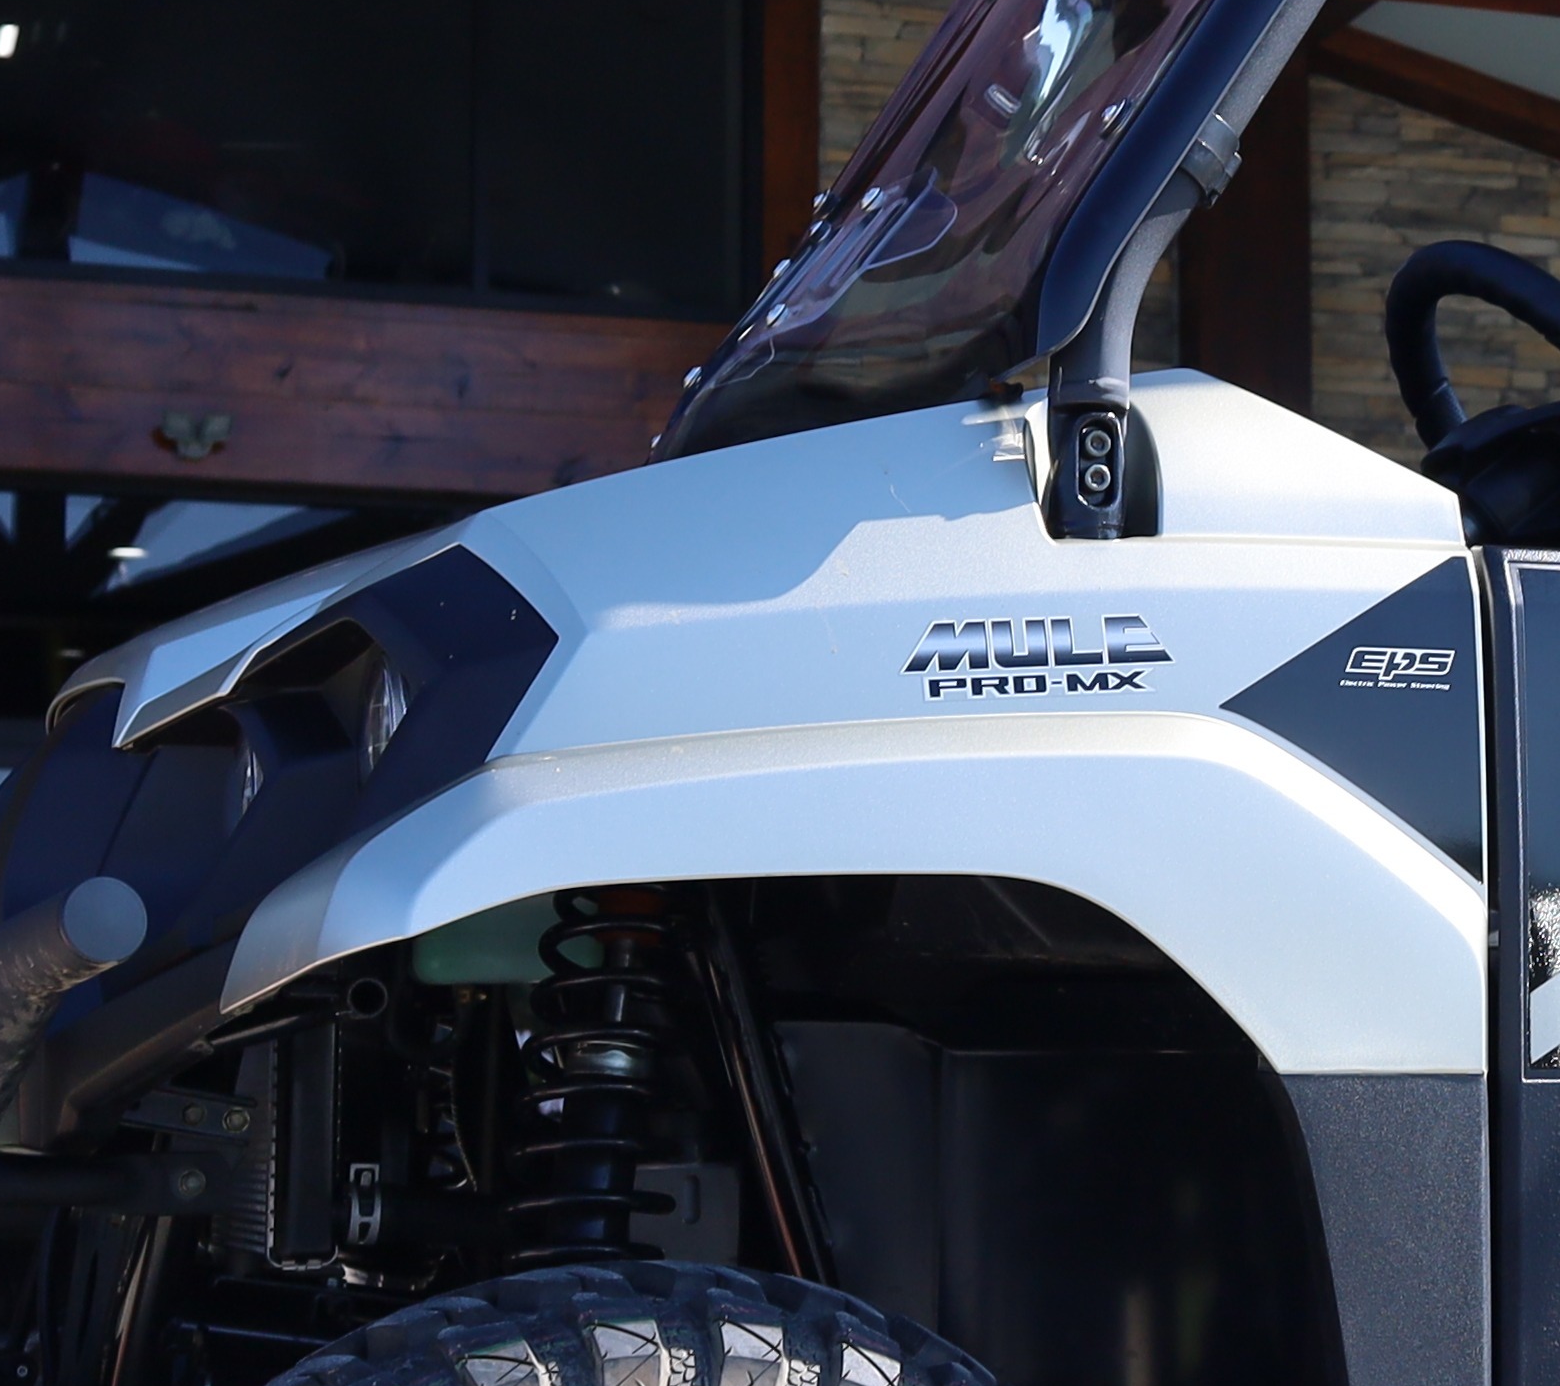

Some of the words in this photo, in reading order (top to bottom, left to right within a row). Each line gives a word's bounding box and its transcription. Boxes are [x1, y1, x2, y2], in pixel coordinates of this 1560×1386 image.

[902, 615, 1175, 673] MULE
[927, 667, 1149, 700] PRO-MX
[1339, 679, 1375, 688] Electric
[1378, 680, 1407, 689] Power
[1410, 681, 1451, 691] Steering
